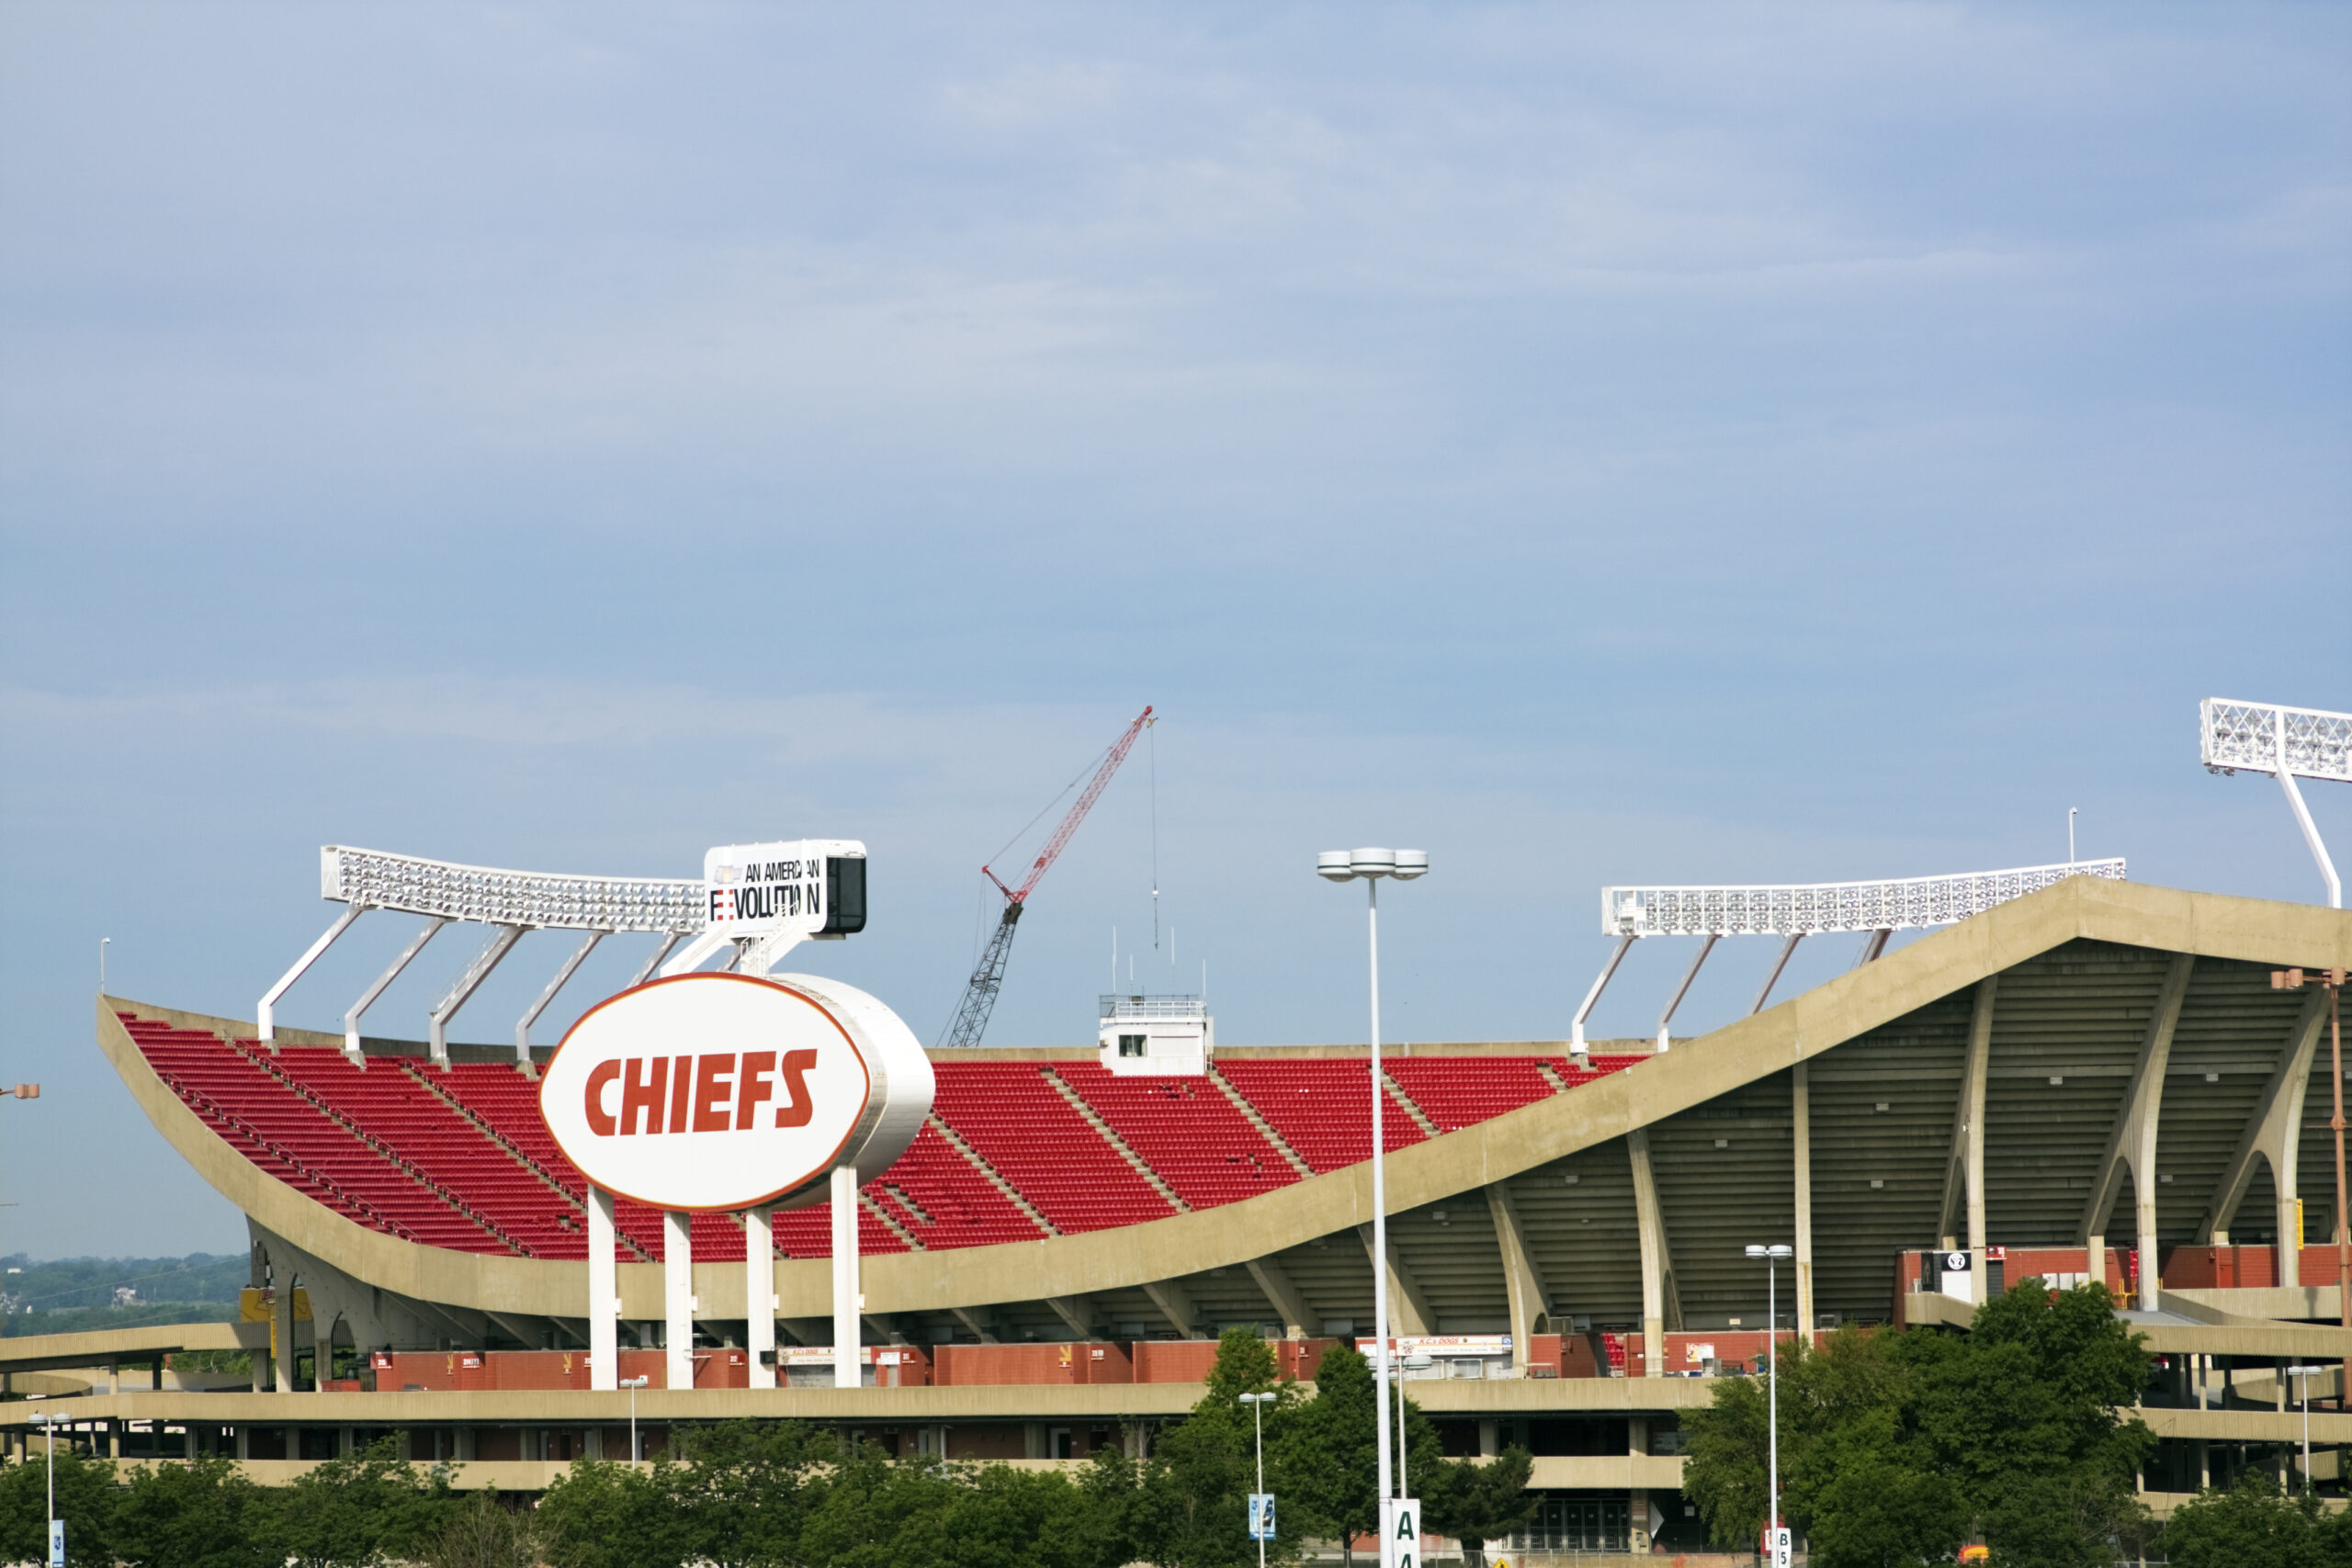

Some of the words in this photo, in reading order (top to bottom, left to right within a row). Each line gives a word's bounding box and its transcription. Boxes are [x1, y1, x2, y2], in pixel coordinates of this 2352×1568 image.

[745, 863, 761, 884] AN
[764, 858, 820, 882] AMERCAN
[584, 1048, 818, 1137] CHIEFS
[1438, 1337, 1459, 1345] DOGS
[1396, 1511, 1415, 1540] A
[1780, 1533, 1789, 1546] B
[1781, 1551, 1787, 1565] 5
